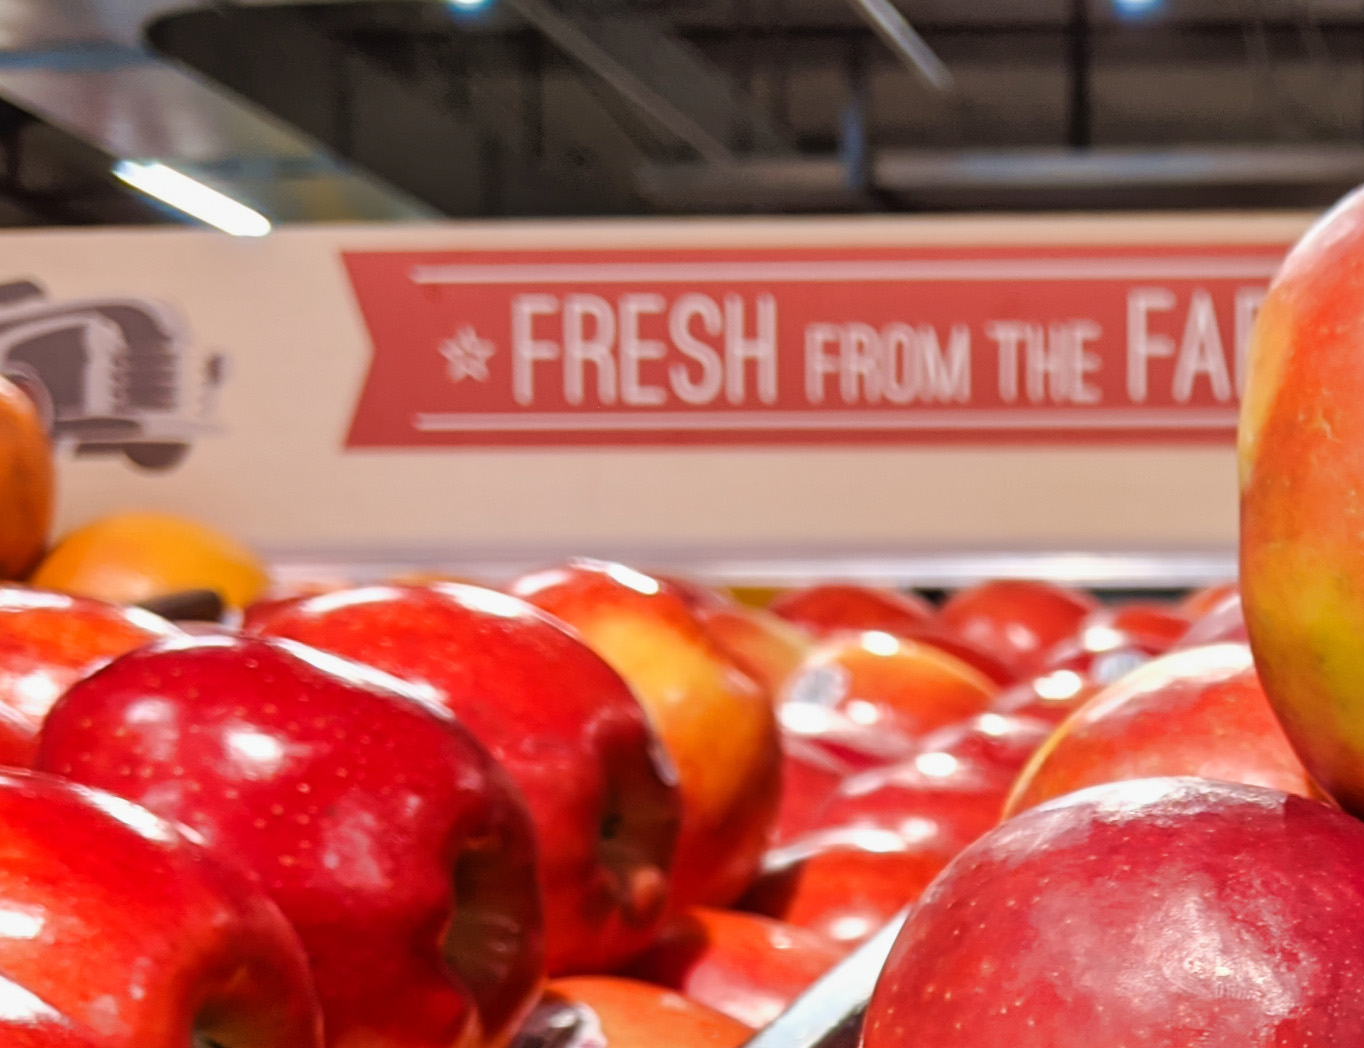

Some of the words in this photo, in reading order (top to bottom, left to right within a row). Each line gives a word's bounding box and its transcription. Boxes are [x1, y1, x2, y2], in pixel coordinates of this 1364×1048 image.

[512, 291, 777, 406] FRESH
[804, 321, 971, 404] FROM
[985, 318, 1103, 404] THE
